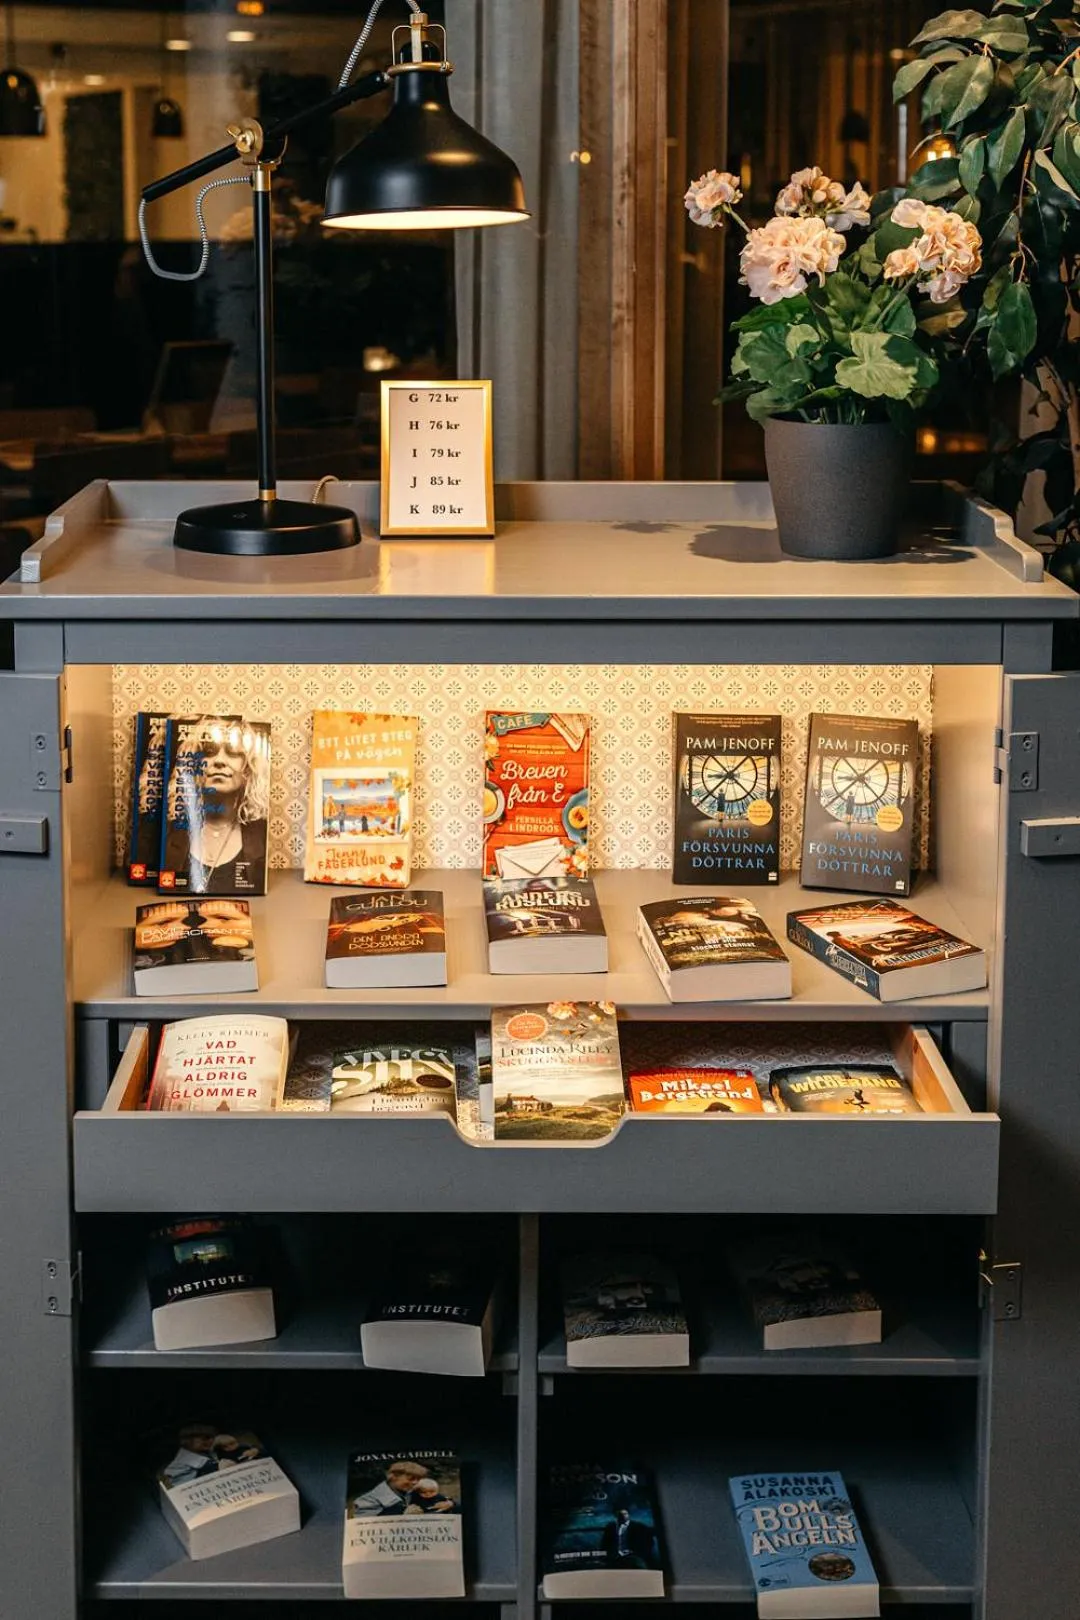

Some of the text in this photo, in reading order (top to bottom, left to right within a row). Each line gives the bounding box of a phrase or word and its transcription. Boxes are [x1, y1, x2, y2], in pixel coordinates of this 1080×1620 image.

[408, 393, 459, 403] G 72 kr
[408, 420, 460, 430] H 76 kr
[411, 448, 461, 458] I 79 kr
[409, 476, 461, 488] J 85 kr
[409, 504, 464, 514] K 89 kr
[318, 737, 339, 748] ETT
[344, 732, 377, 746] LITET
[686, 737, 775, 752] PAM JENOFF
[817, 737, 909, 756] PAM JENOFF
[500, 760, 568, 780] Breven
[507, 782, 565, 810] från E
[509, 823, 560, 833] LINDROOS
[708, 827, 750, 838] PARIS
[835, 831, 878, 843] PARIS
[326, 847, 366, 859] Jenny
[682, 841, 775, 854] FÖRSVUNNA
[318, 855, 386, 870] FAGERLUND
[692, 857, 765, 869] DÖTTRAR
[501, 890, 582, 903] ANDERS
[205, 1040, 237, 1050] VAD
[501, 1044, 565, 1058] LUCINDA
[182, 1054, 257, 1067] HJÄRTAT
[184, 1071, 248, 1083] ALDRIG
[660, 1078, 731, 1092] Mikael
[171, 1087, 258, 1100] GLÖMMER
[640, 1087, 754, 1103] Bergstrand
[381, 1304, 472, 1317] INSTITUTET
[354, 1450, 457, 1463] JONAS GARDELL
[740, 1475, 834, 1490] SUSANNA
[743, 1486, 836, 1501] ALAKOSKI
[358, 1527, 383, 1537] TILL
[389, 1526, 434, 1536] MINNE
[752, 1528, 857, 1556] ÄNGELN
